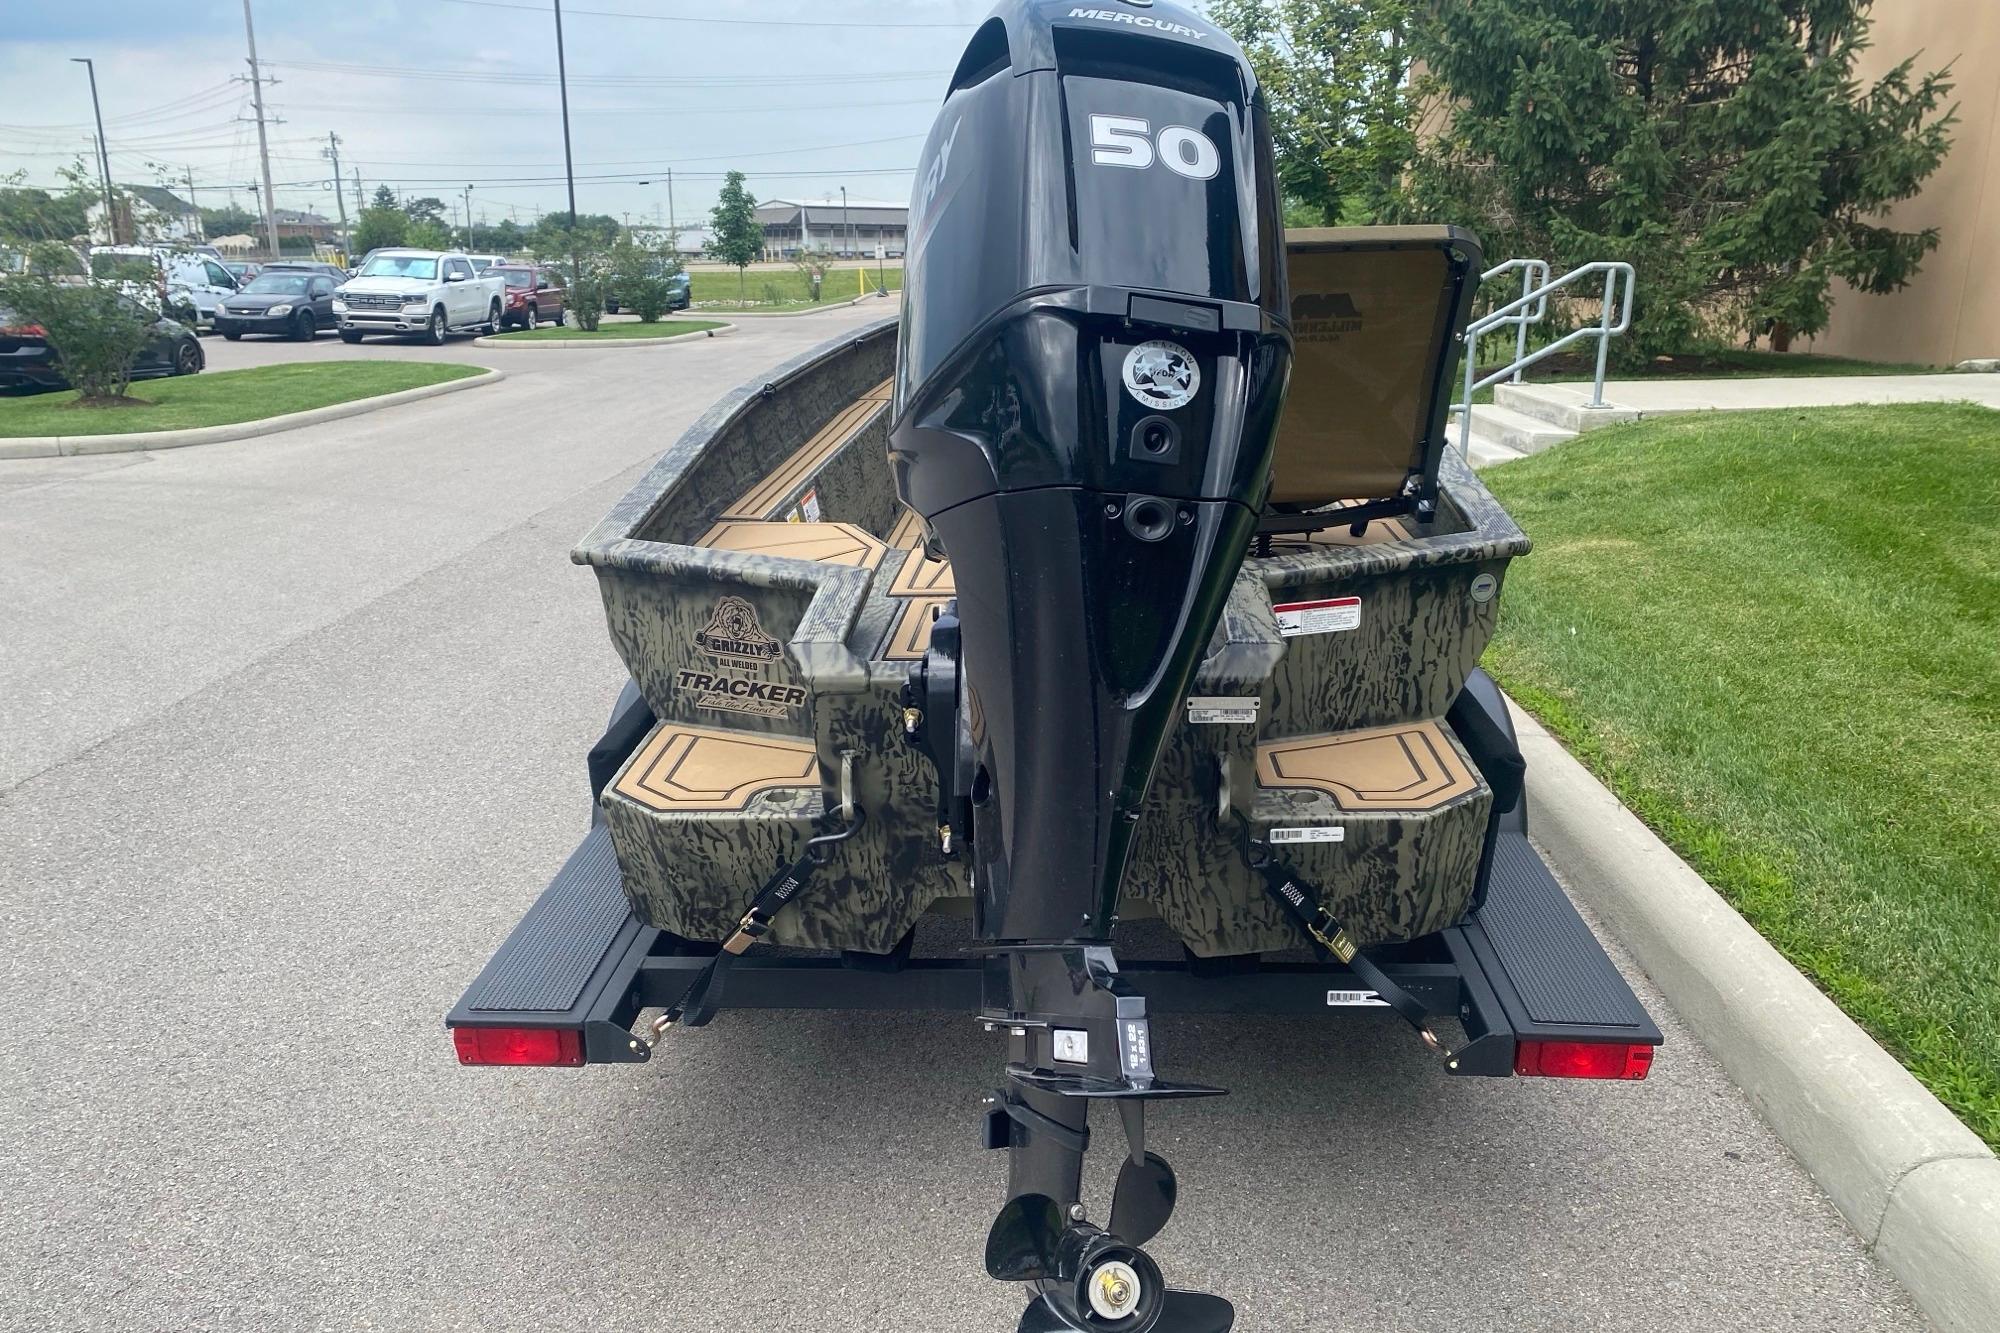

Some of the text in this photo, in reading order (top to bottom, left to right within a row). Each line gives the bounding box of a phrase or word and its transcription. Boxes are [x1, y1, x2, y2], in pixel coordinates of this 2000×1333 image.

[1068, 7, 1209, 40] MERCURY
[1088, 113, 1221, 181] 50
[1134, 341, 1195, 364] ULTRA LOW
[1135, 390, 1187, 408] EMISSION
[711, 639, 763, 656] GRIZZLY
[719, 658, 758, 671] ALL WELDED
[678, 671, 806, 705] TRACKER
[699, 695, 723, 706] Fish
[724, 697, 741, 709] the
[1127, 1024, 1136, 1042] 22
